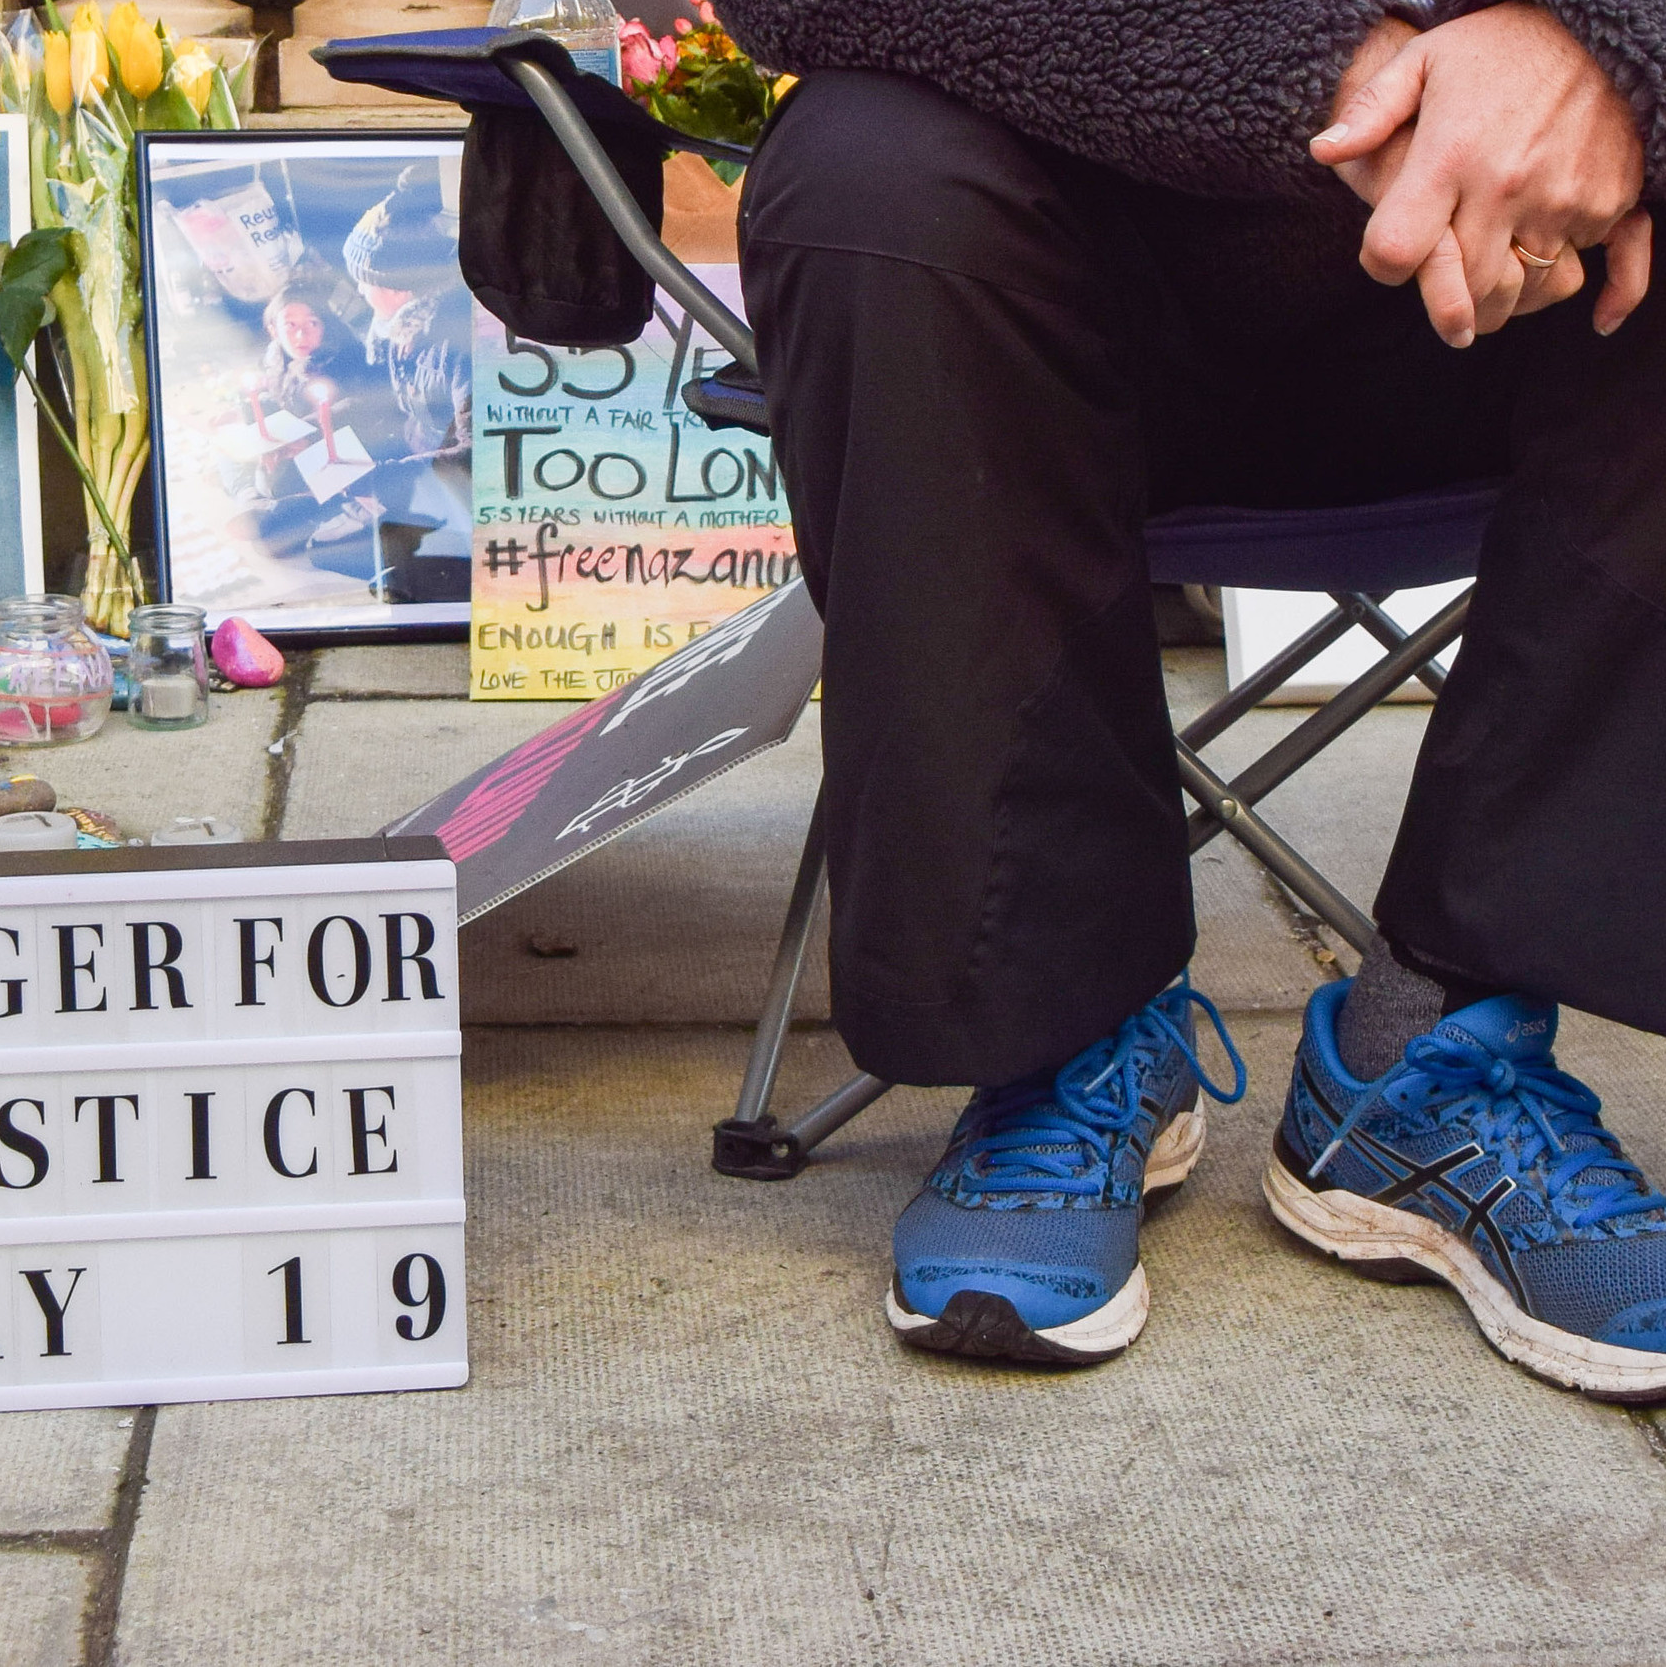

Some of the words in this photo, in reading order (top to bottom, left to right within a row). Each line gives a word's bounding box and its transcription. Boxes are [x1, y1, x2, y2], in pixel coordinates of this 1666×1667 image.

[487, 403, 575, 424] WITHOUT
[584, 406, 600, 426] A
[608, 408, 658, 432] FAIR
[483, 425, 648, 501] TOO
[665, 421, 785, 504] LON
[516, 507, 582, 526] YEARS
[593, 508, 668, 528] WITHOUT
[673, 511, 689, 529] A
[699, 508, 780, 531] MOTHER
[478, 621, 617, 656] ENOUGH
[479, 669, 526, 691] LOVE
[539, 669, 587, 690] THE
[233, 912, 447, 1007] FOR
